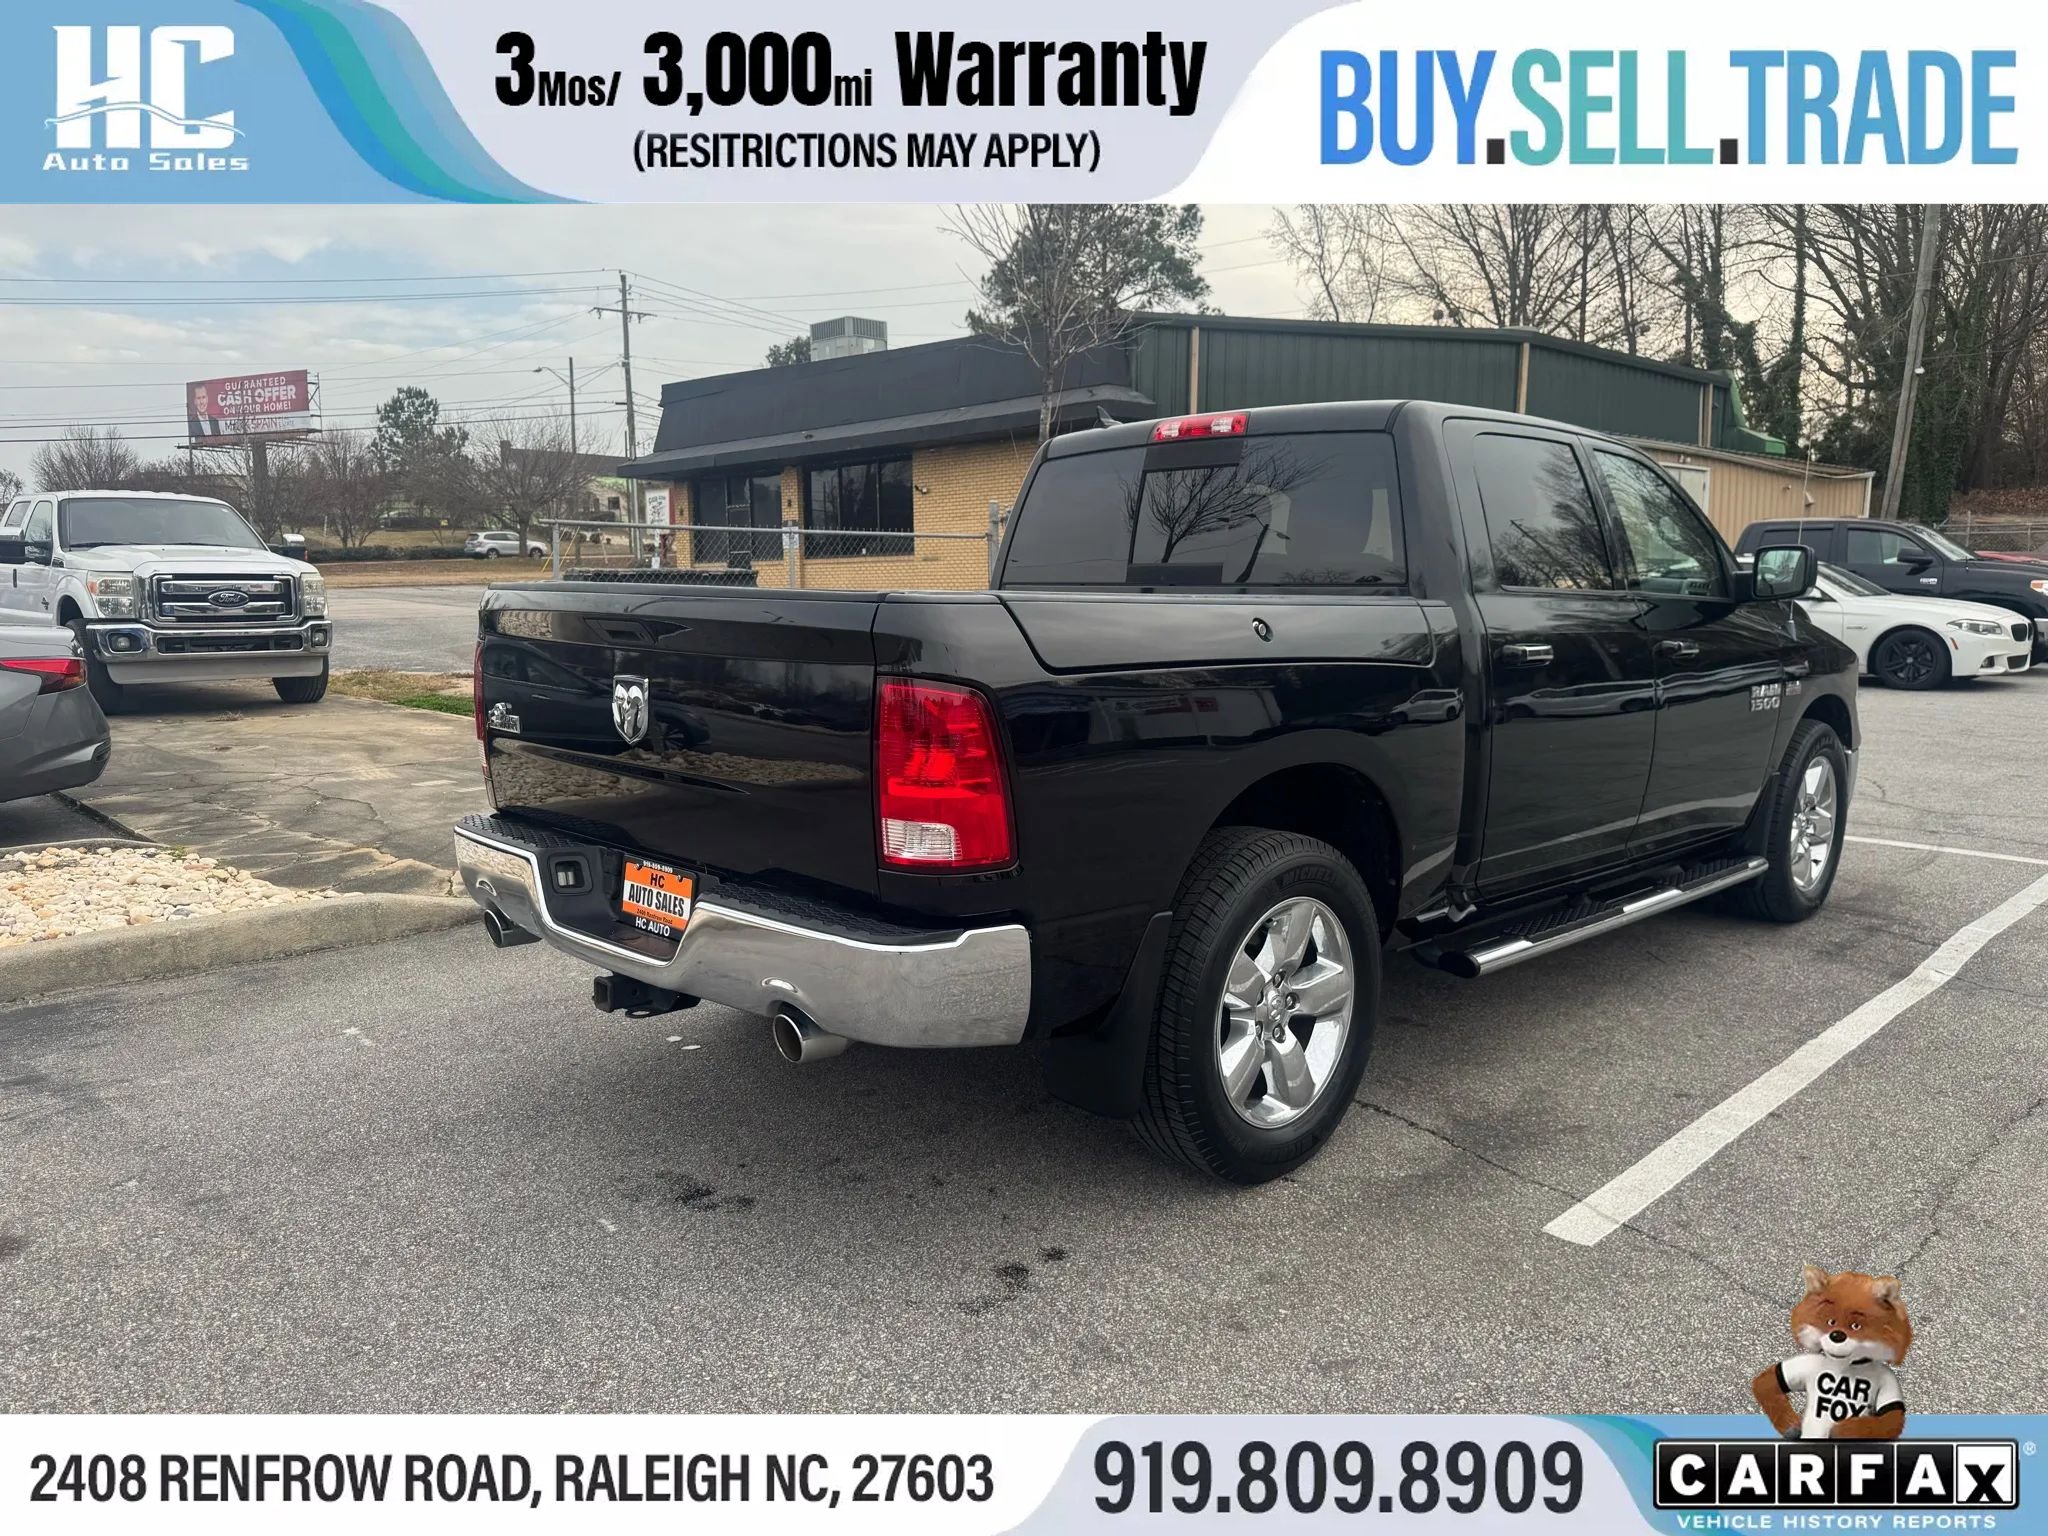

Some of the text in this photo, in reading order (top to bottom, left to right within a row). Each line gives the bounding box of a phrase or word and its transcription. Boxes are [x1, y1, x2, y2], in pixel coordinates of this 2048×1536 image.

[225, 376, 287, 391] GUARANTEED
[217, 384, 297, 407] CASH OFFER
[223, 401, 292, 416] ON YOUR HOME!
[219, 593, 241, 602] Ford
[1751, 697, 1780, 712] 1500
[650, 872, 666, 888] HC
[628, 884, 685, 918] AUTO SALES
[635, 916, 671, 937] HC AUTO
